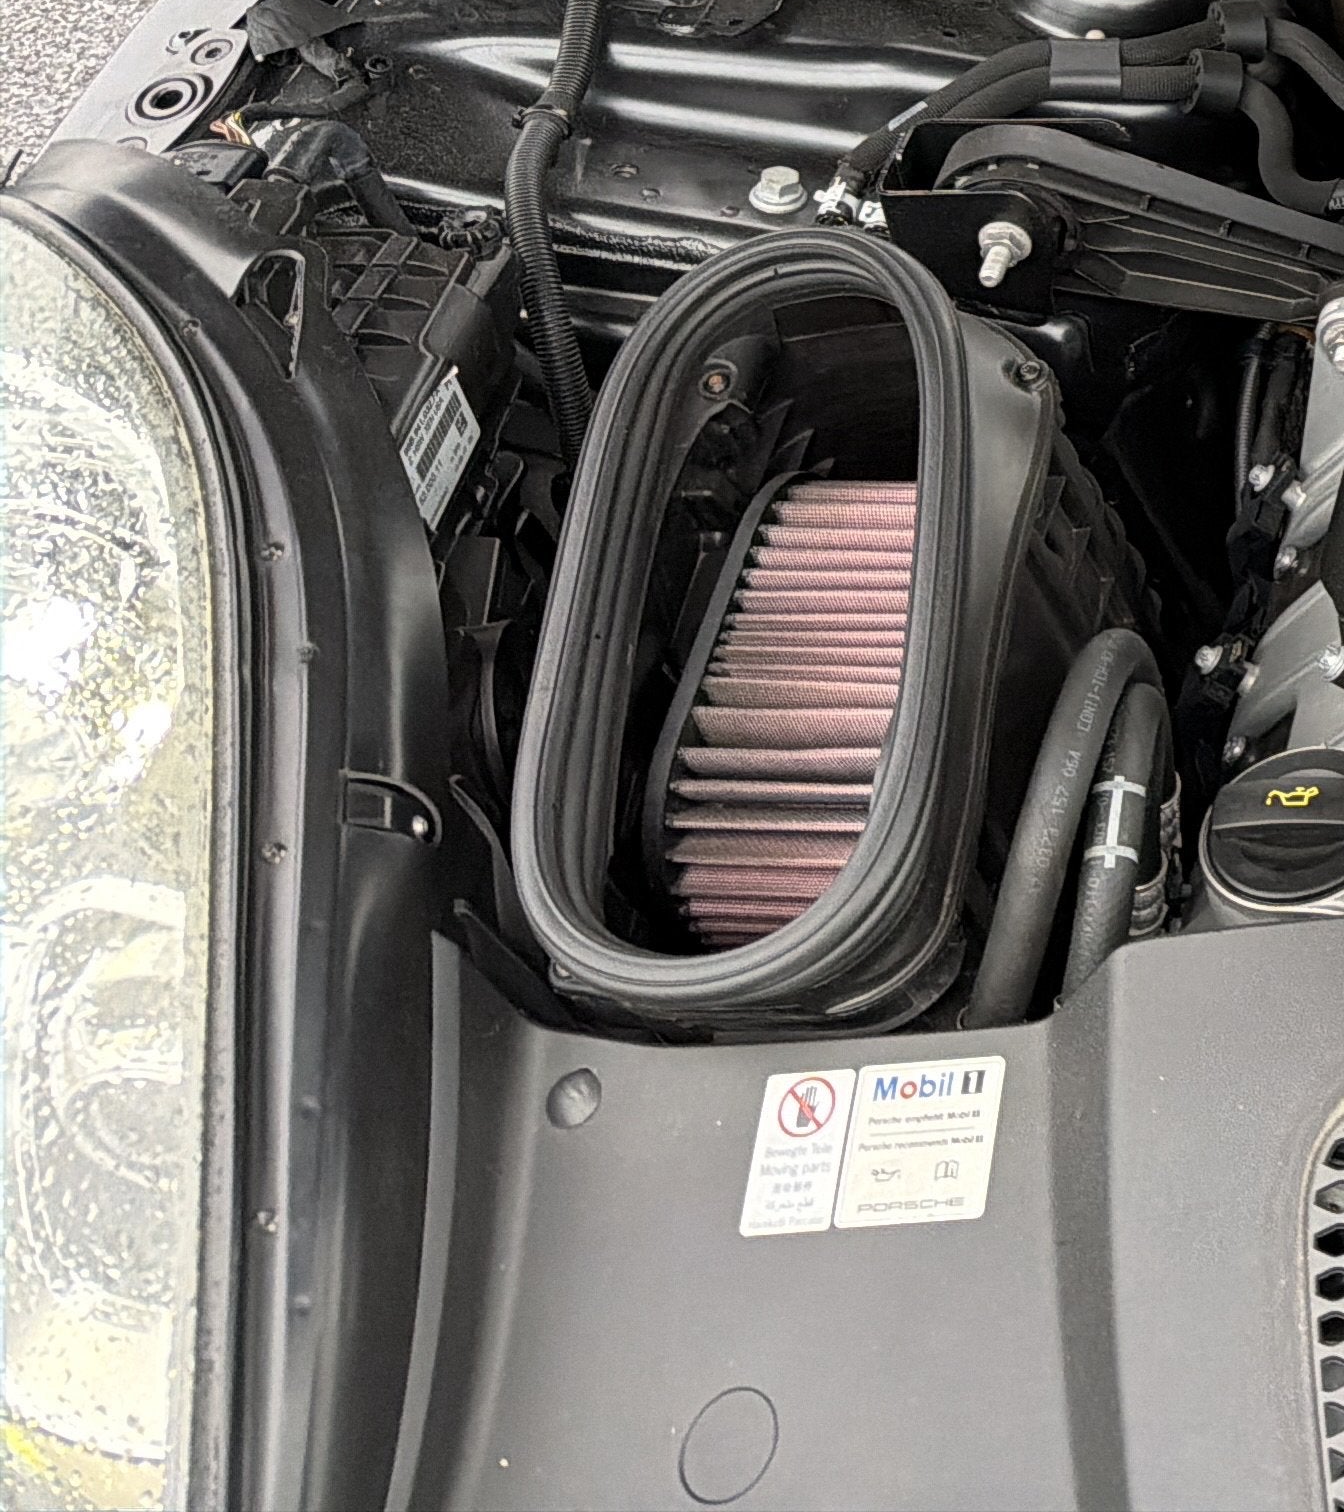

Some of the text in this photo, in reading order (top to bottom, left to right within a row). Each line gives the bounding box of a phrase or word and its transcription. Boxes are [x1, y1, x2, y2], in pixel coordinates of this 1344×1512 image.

[872, 1071, 955, 1102] Mobil
[760, 1161, 832, 1177] Moving parts
[857, 1196, 965, 1213] PORSCHE
